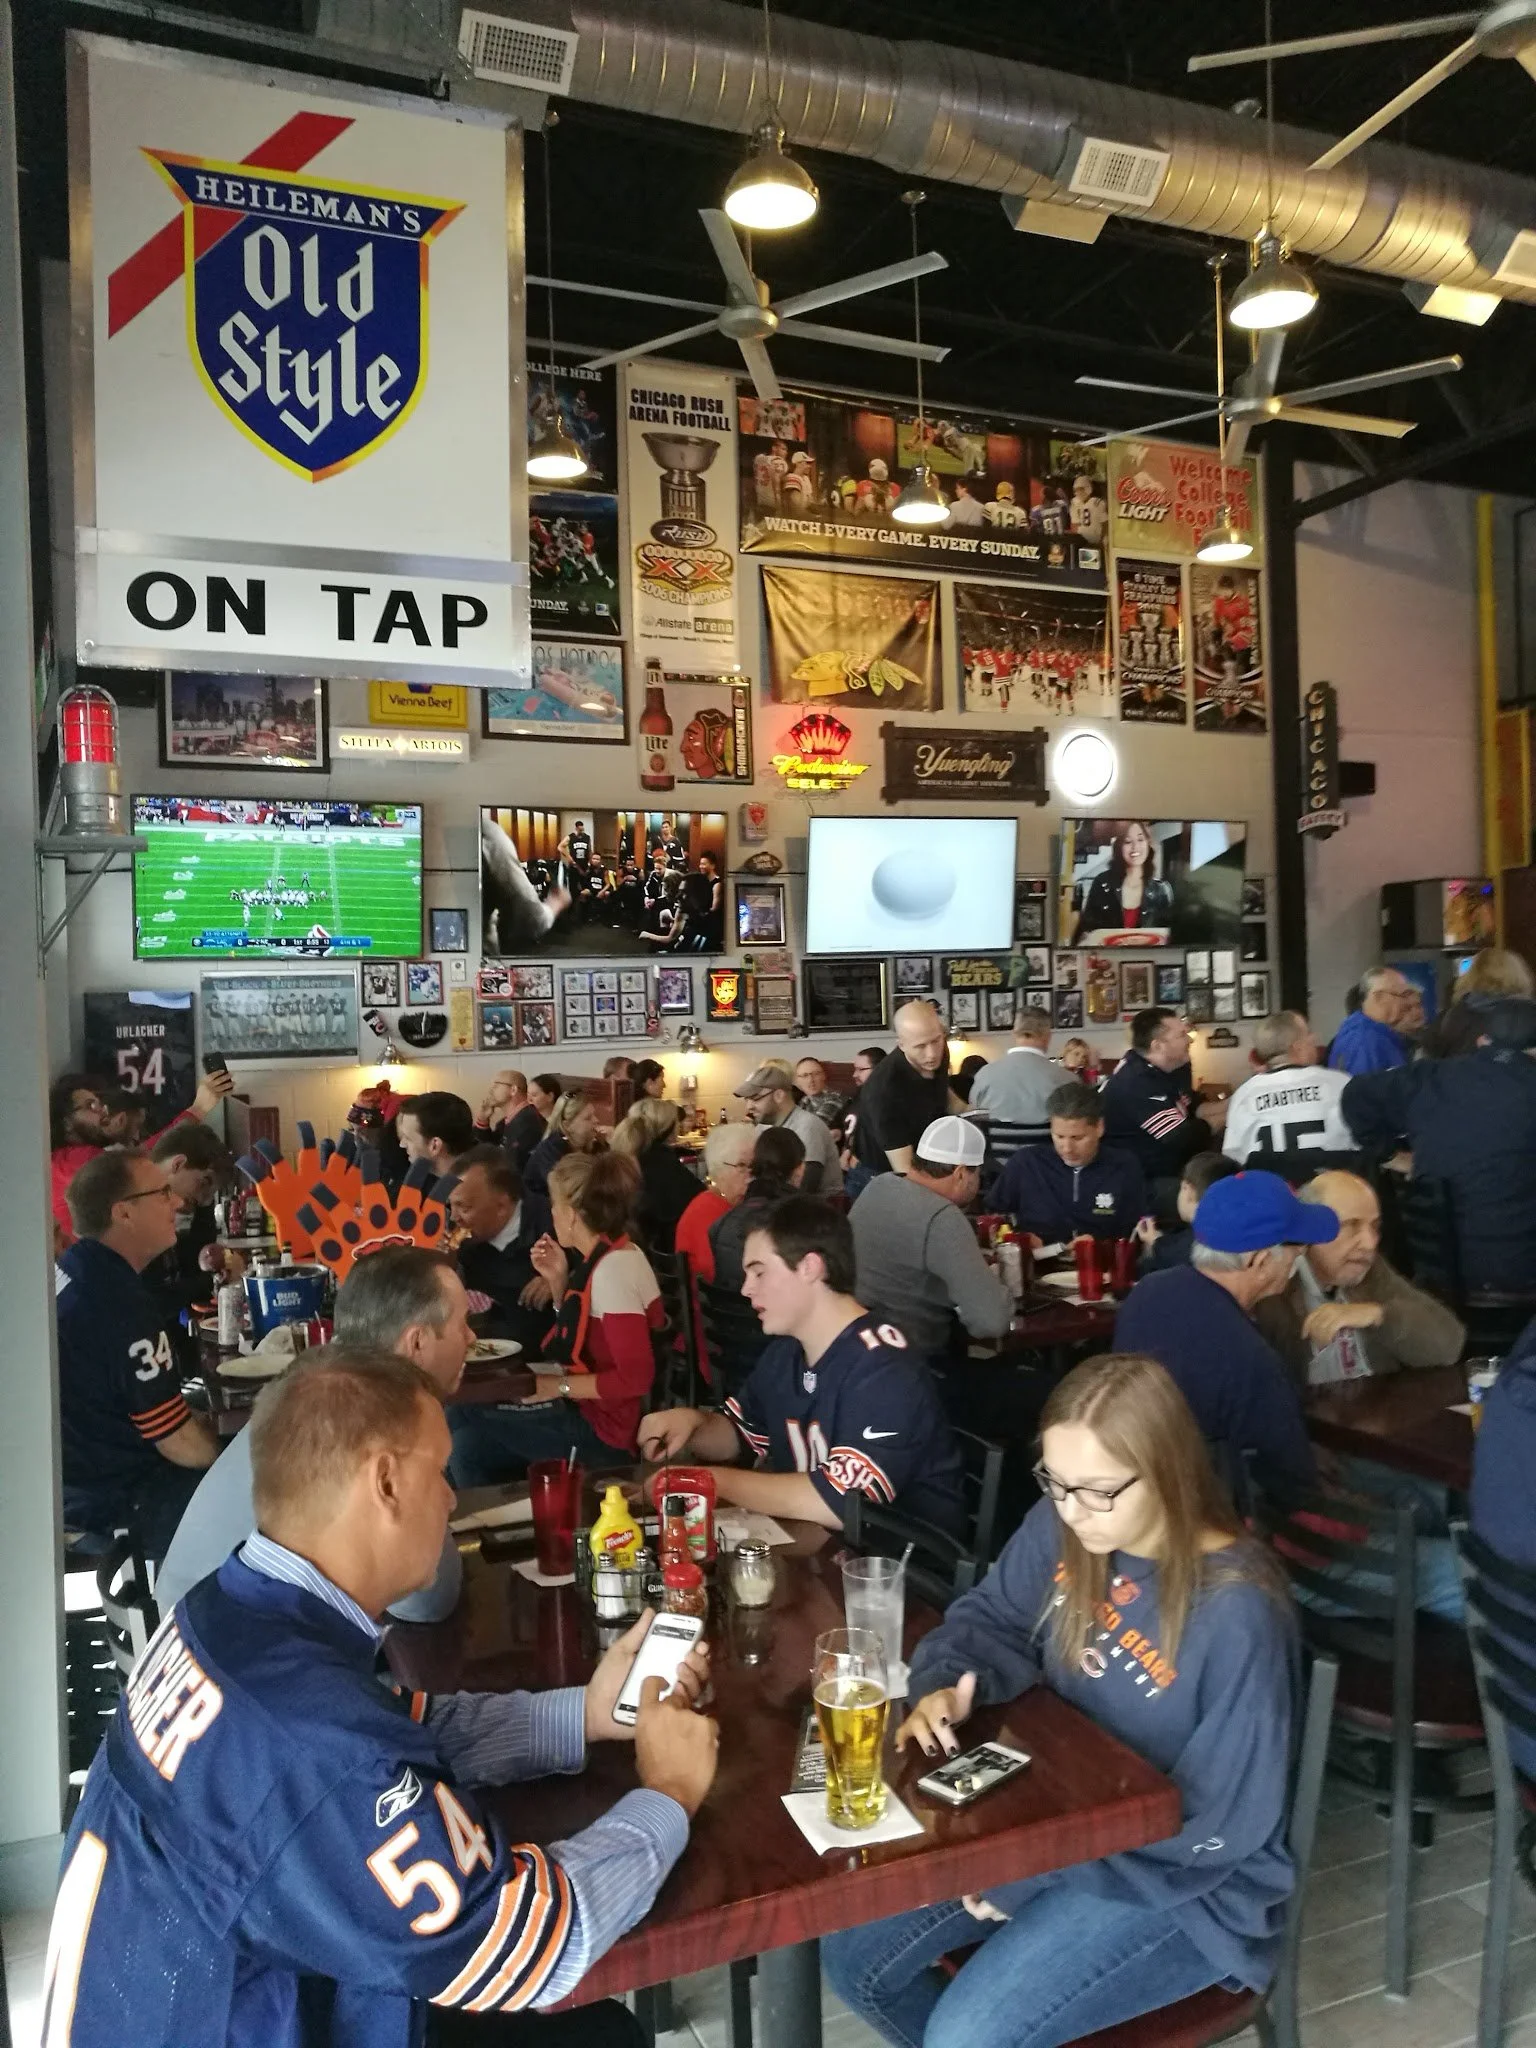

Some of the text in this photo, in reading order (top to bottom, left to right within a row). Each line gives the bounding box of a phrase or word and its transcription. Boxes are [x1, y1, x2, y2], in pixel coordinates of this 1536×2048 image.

[195, 174, 421, 234] HEILEMAN'S
[243, 224, 375, 324] Old
[217, 309, 401, 445] Style
[631, 388, 723, 414] CHICAGO RUSH
[629, 405, 732, 432] ARENA FOOTBALL
[1117, 502, 1168, 522] LIGHT
[764, 516, 821, 536] WATCH
[825, 523, 878, 541] EVERY
[929, 535, 979, 553] EVERY
[126, 570, 488, 648] ON TAP
[668, 586, 732, 606] CHAMPIONS
[655, 618, 733, 632] Allstate arena
[1122, 672, 1184, 684] CHAMPIONS
[389, 694, 453, 711] Vienna Beef
[646, 736, 669, 752] Lite
[1308, 690, 1328, 809] CHICAGO
[913, 744, 1018, 780] Yuengling
[786, 778, 853, 790] SELECT
[950, 972, 1002, 987] BEARS
[116, 1024, 165, 1038] URLACHER
[117, 1047, 166, 1095] 54
[1255, 1085, 1322, 1111] CRABTREE
[272, 1297, 301, 1307] LIGHT
[275, 1292, 298, 1300] BUD
[858, 1323, 908, 1350] 10
[128, 1330, 173, 1381] 34
[366, 1780, 494, 1936] 54
